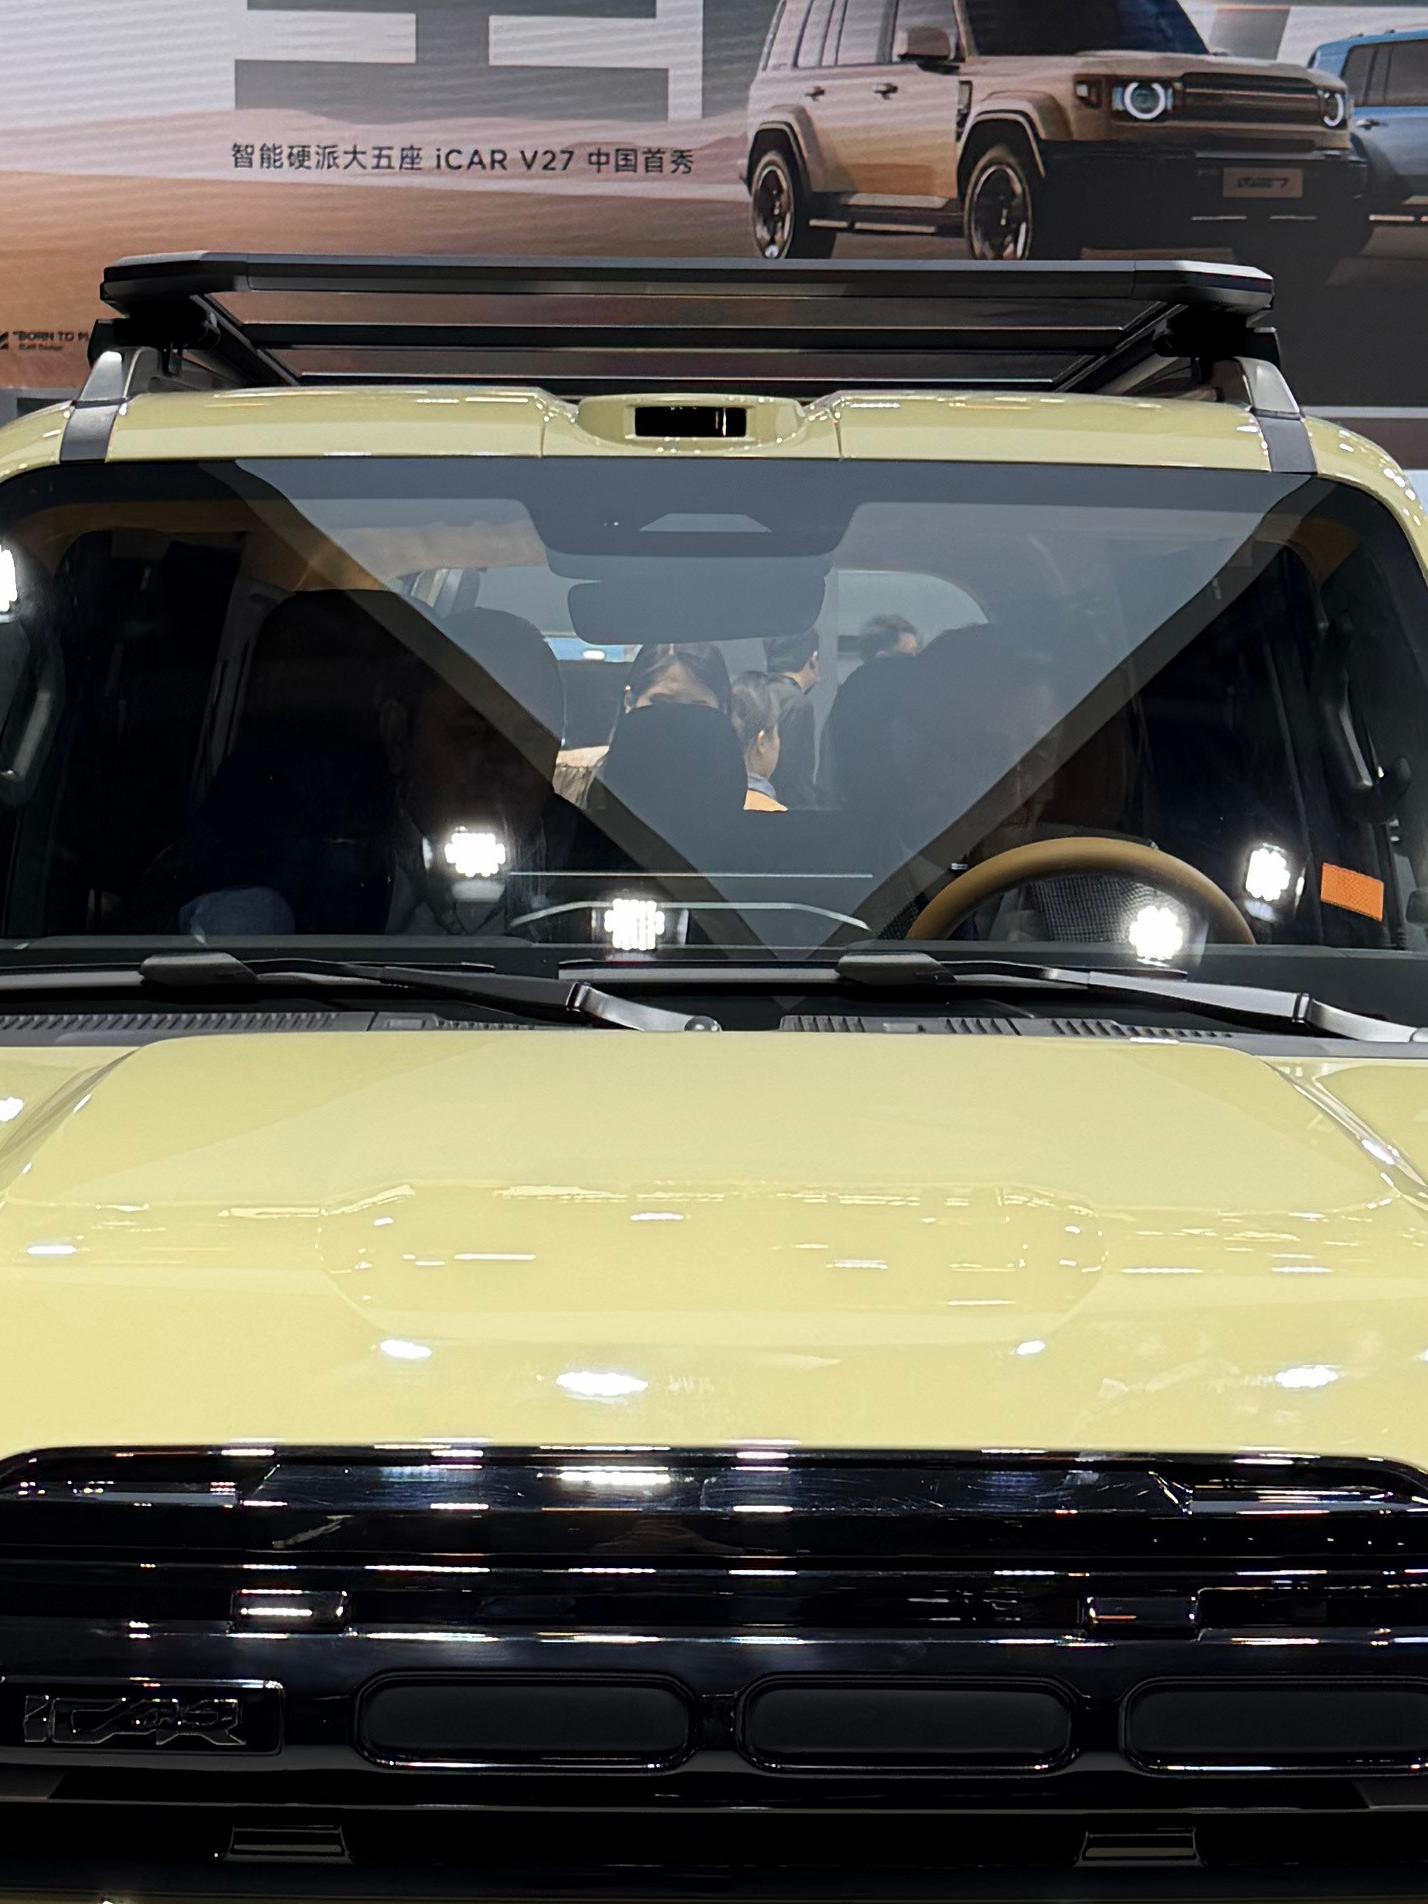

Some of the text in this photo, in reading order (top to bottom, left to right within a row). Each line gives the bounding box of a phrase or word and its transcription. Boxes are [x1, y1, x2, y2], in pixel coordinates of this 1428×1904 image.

[231, 143, 695, 175] 智能硬派大五座 iCAR V27 中国首秀
